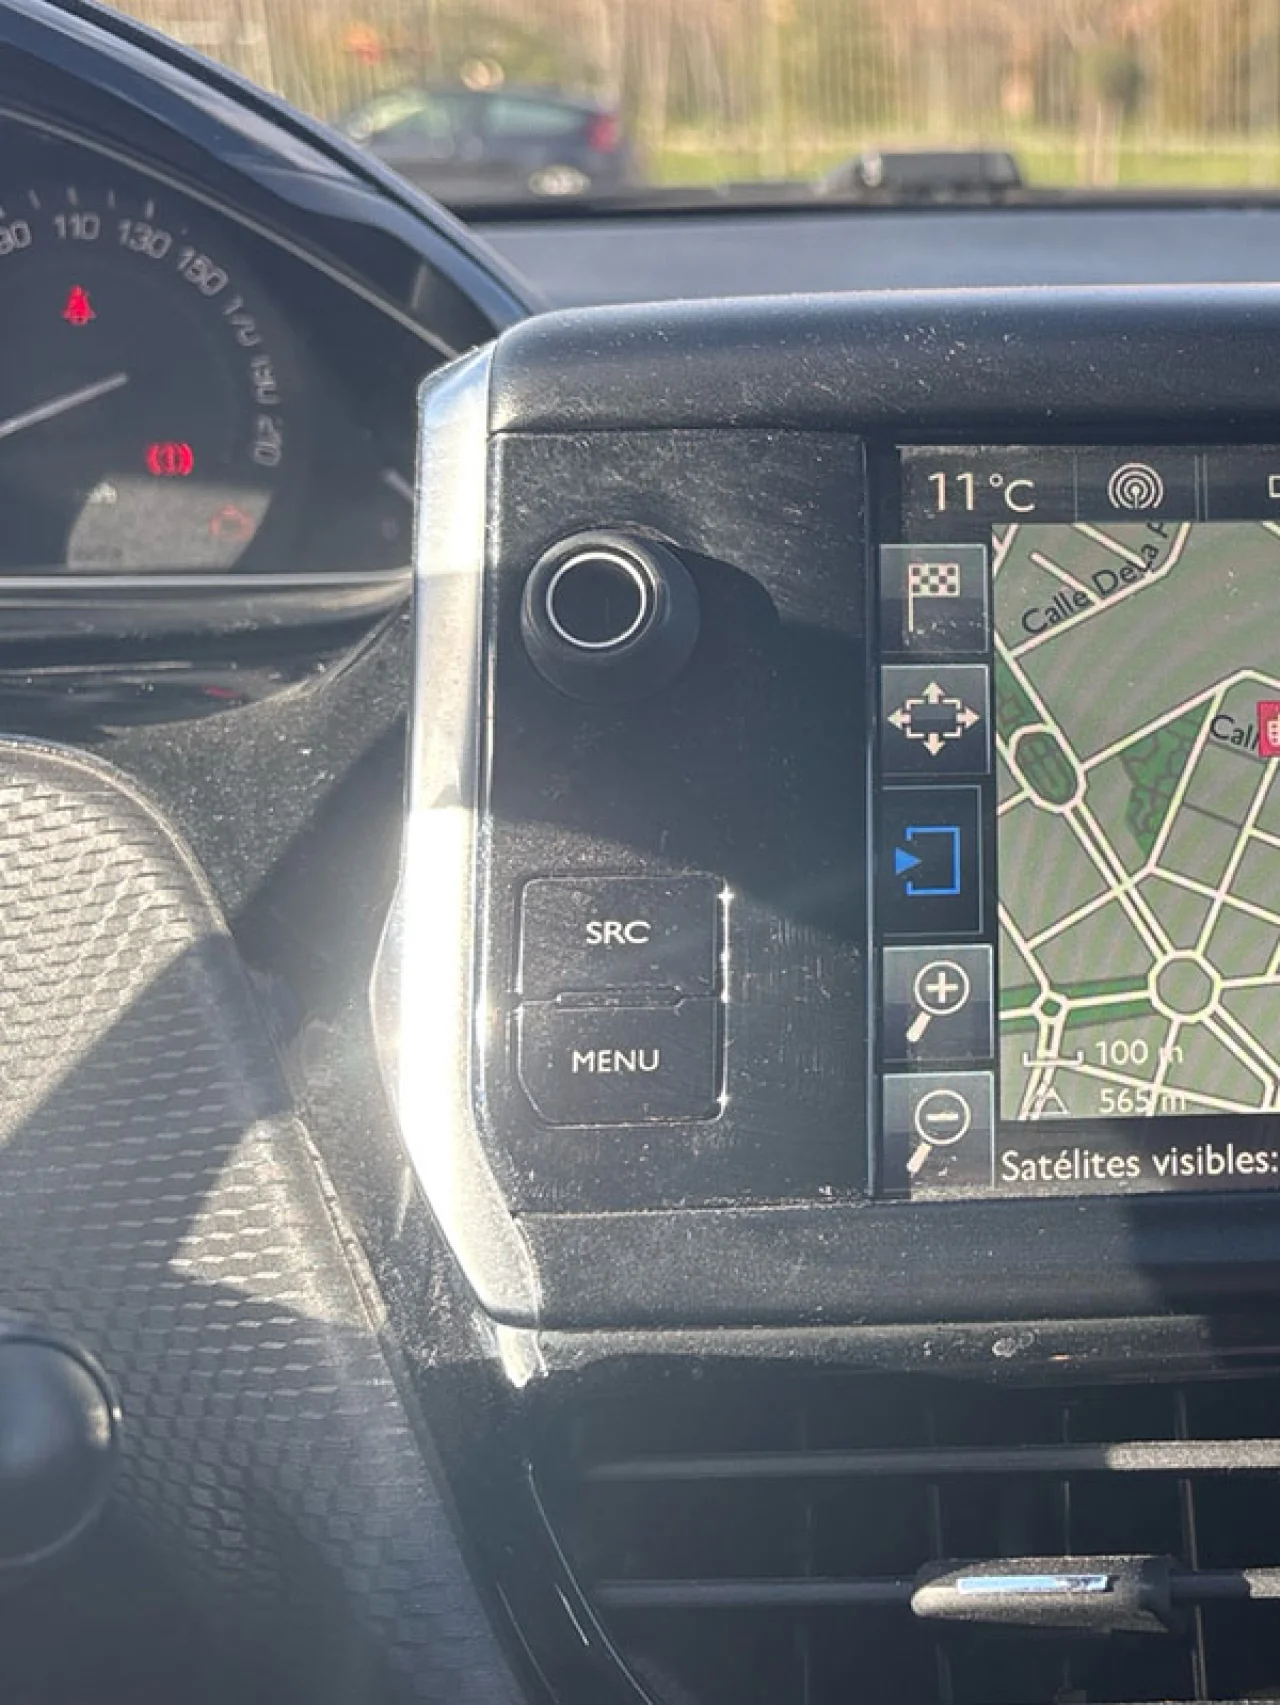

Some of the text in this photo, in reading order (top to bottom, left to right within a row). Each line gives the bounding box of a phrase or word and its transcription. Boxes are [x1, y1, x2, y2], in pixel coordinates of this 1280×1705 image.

[54, 212, 100, 240] 110
[118, 218, 173, 259] 130
[1021, 591, 1089, 634] Calle
[1211, 714, 1259, 751] Call
[586, 920, 651, 944] SRC
[572, 1049, 660, 1073] MENU
[1096, 1039, 1149, 1066] 100
[1099, 1087, 1151, 1113] 565
[1001, 1147, 1141, 1182] Satélites
[1152, 1143, 1279, 1177] visibles:
